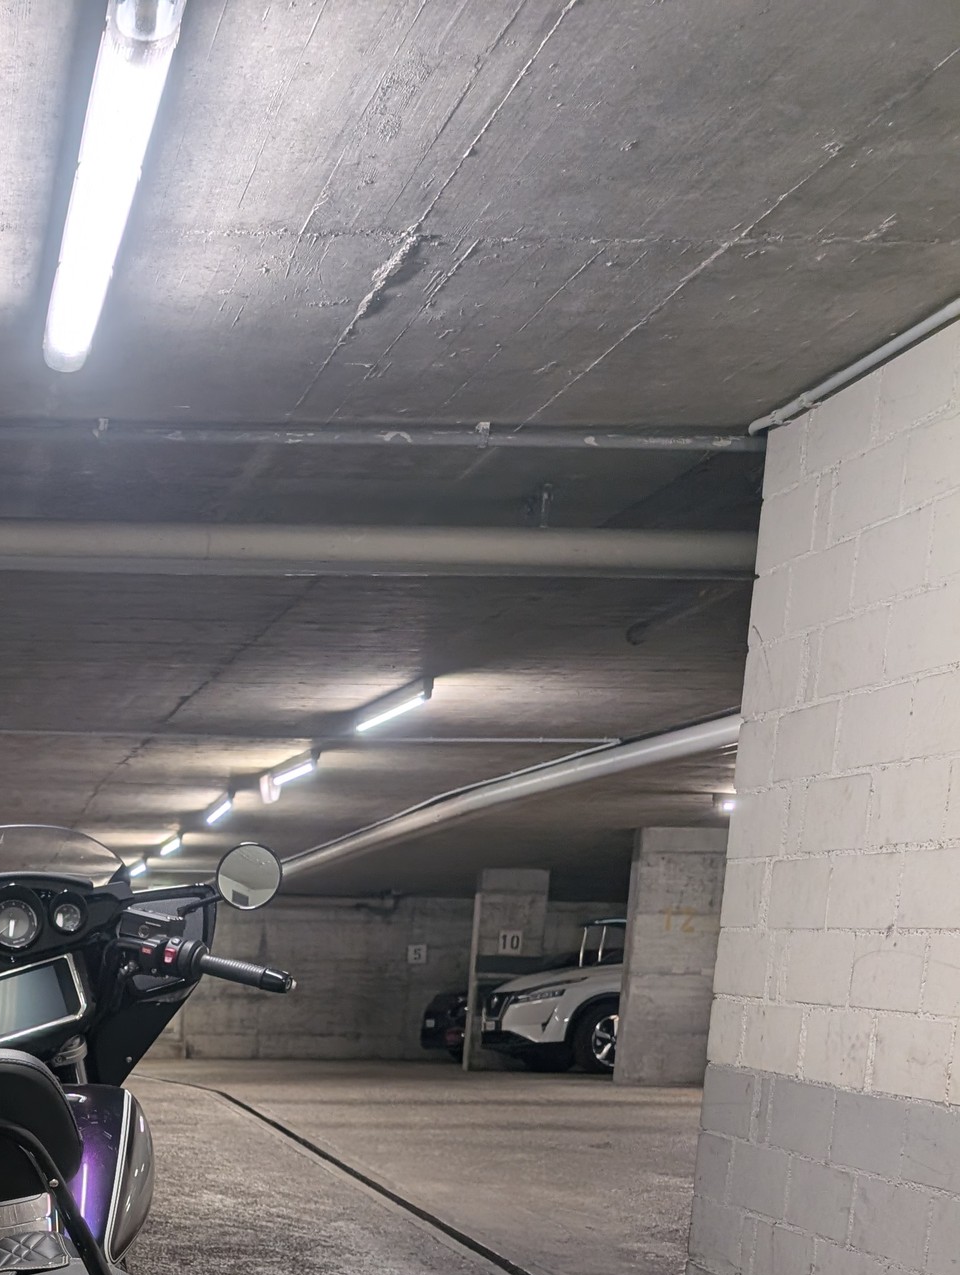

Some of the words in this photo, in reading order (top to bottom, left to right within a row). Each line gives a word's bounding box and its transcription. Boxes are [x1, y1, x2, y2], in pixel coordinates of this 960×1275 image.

[664, 907, 695, 933] 12
[502, 934, 520, 950] 10
[413, 948, 421, 960] 5
